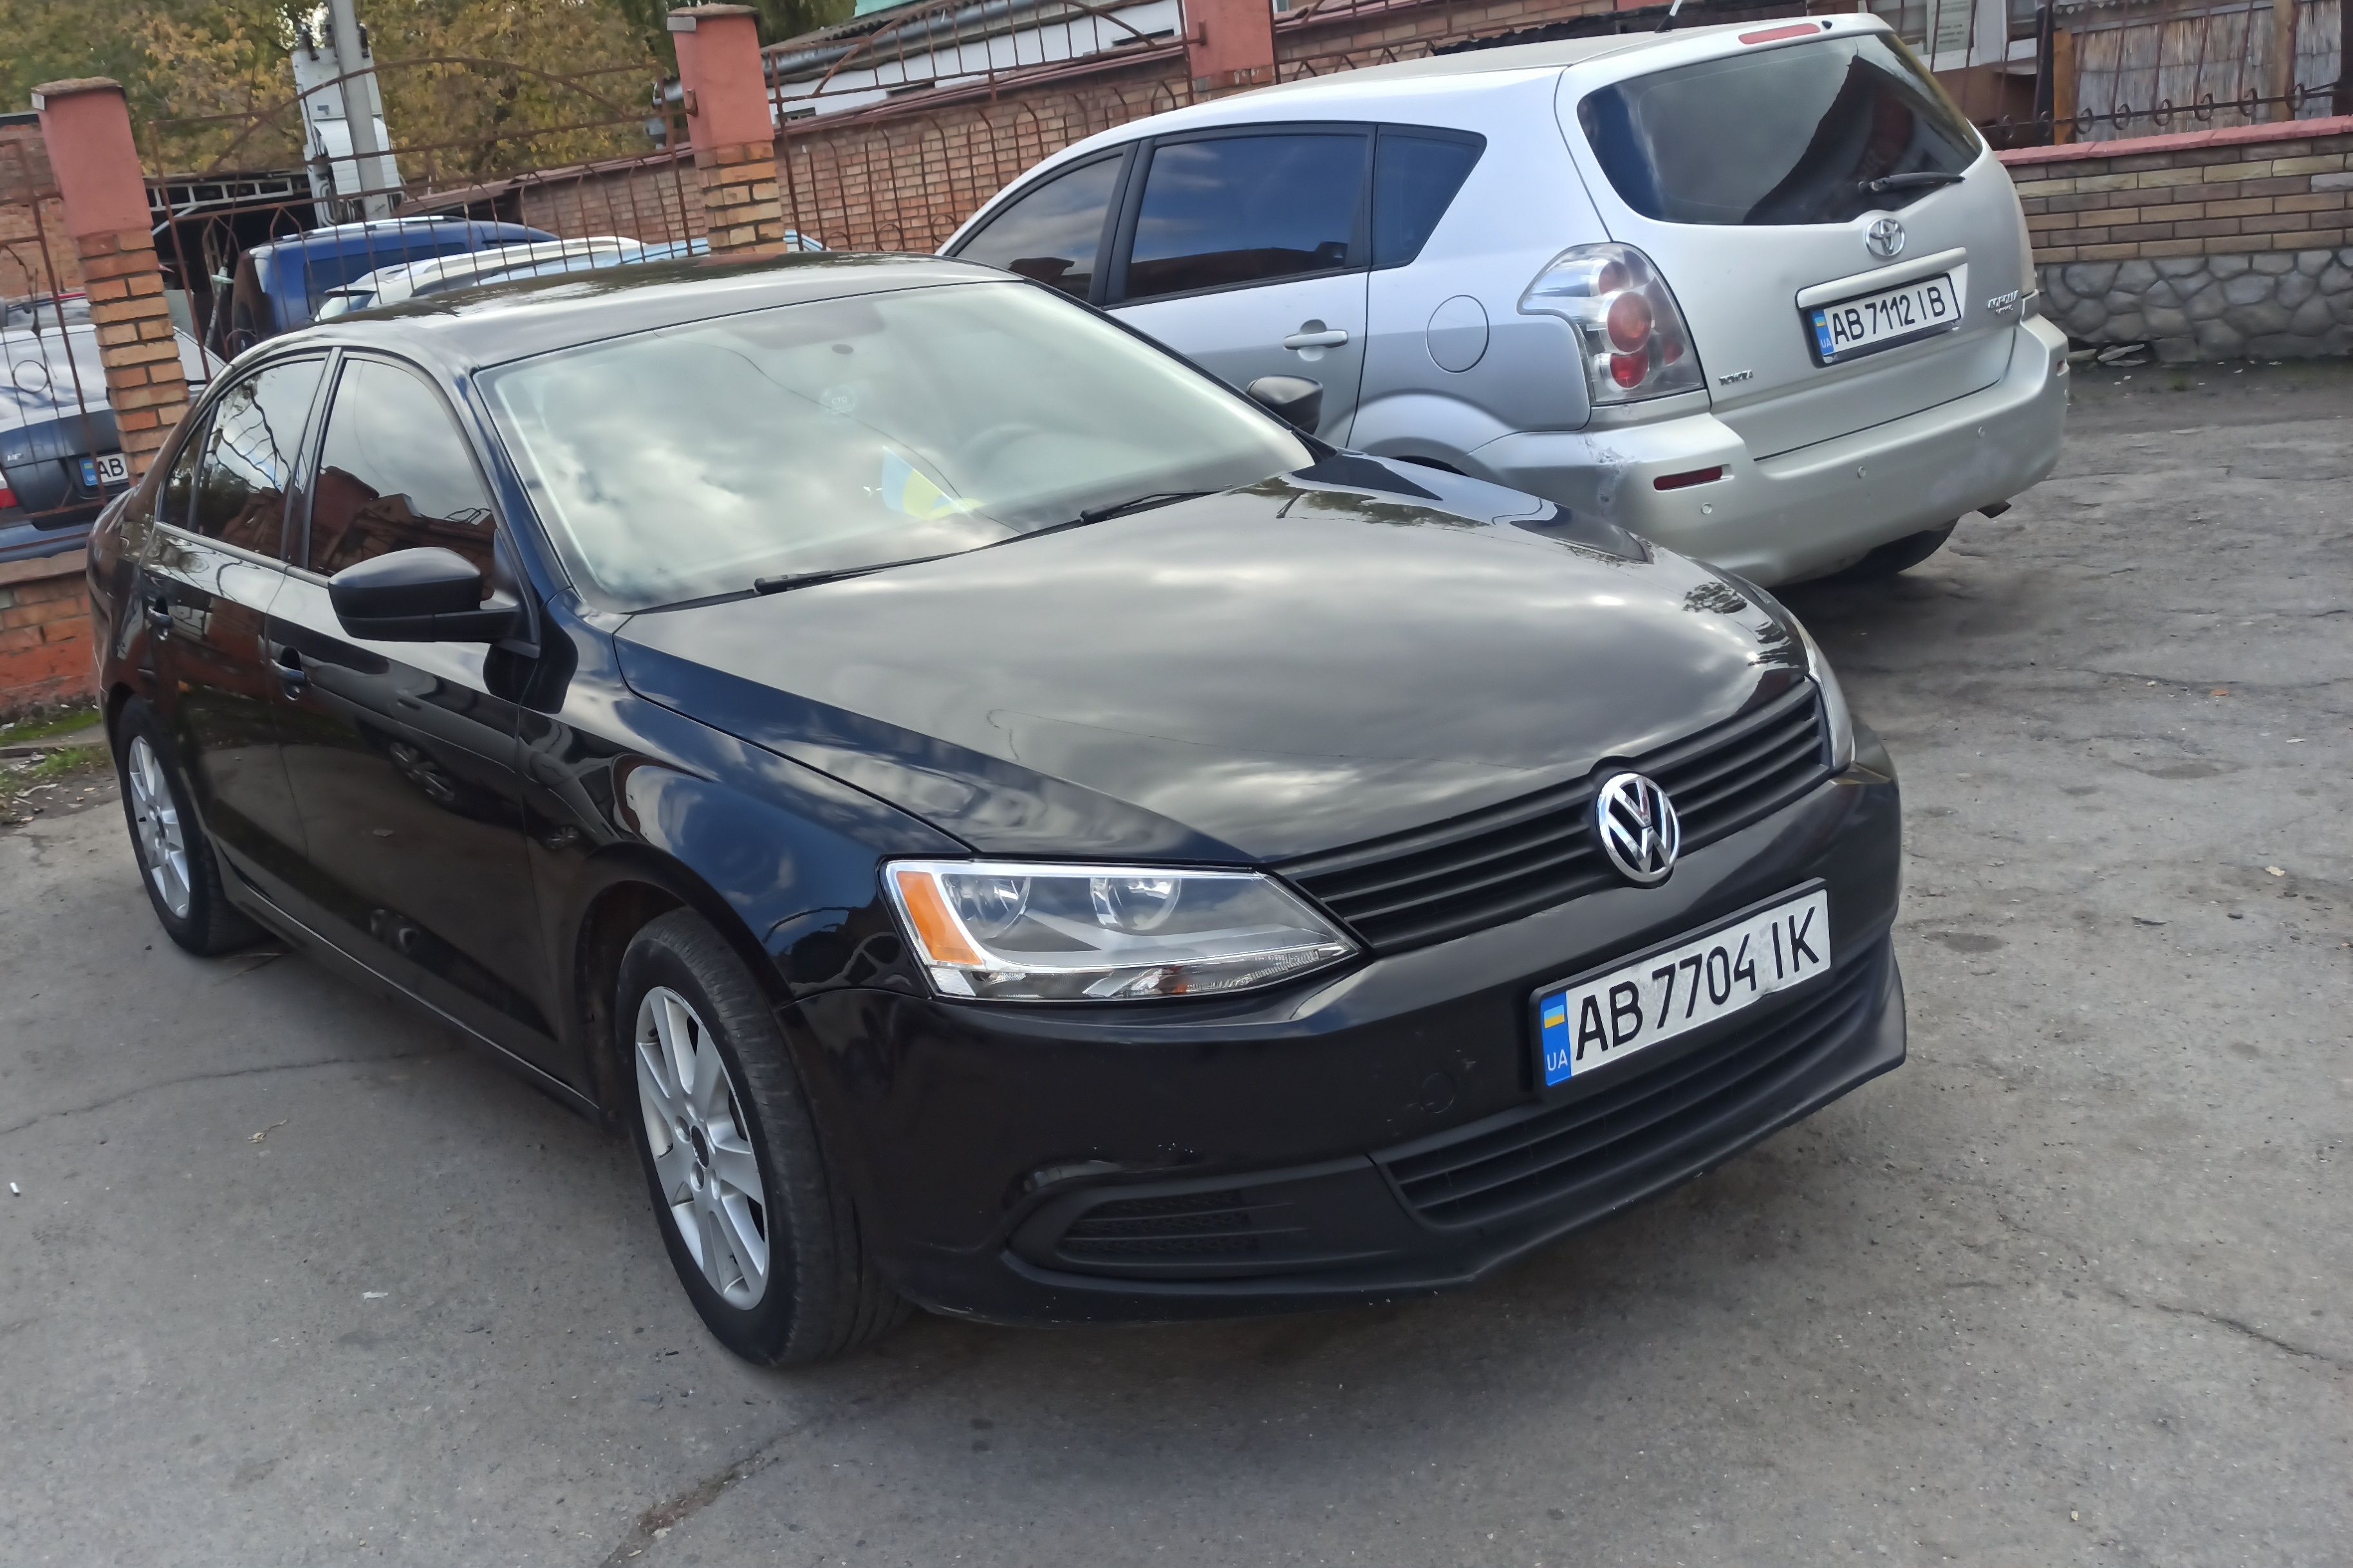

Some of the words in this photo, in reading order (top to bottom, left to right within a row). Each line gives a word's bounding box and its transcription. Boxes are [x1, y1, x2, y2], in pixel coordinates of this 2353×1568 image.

[1832, 308, 1865, 346] AB
[1865, 295, 1915, 335] 7112
[1917, 286, 1946, 320] IB
[1820, 338, 1832, 348] UA
[98, 457, 124, 477] AB
[1576, 981, 1643, 1060] AB
[1652, 933, 1756, 1029] 7704
[1771, 905, 1819, 979] IK
[1547, 1048, 1568, 1071] UA
